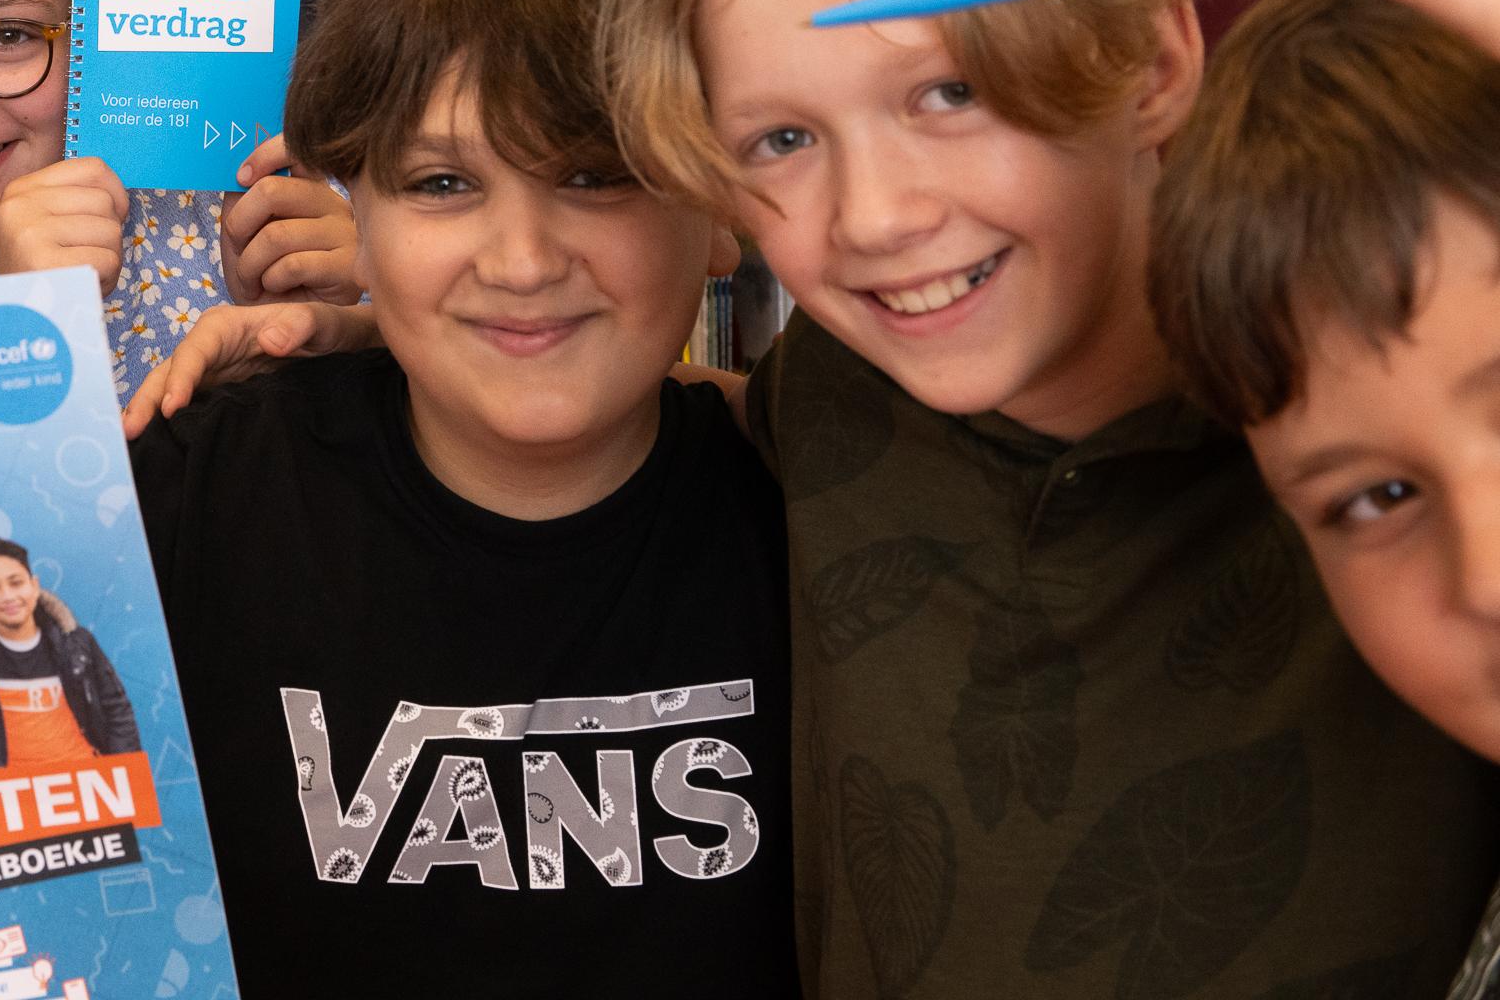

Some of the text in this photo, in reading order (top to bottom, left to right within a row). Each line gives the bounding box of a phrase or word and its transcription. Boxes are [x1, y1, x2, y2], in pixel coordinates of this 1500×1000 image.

[106, 7, 248, 46] verdrag
[101, 92, 199, 110] Voor iedereen
[100, 112, 190, 127] onder de 18!
[280, 678, 760, 890] VANS
